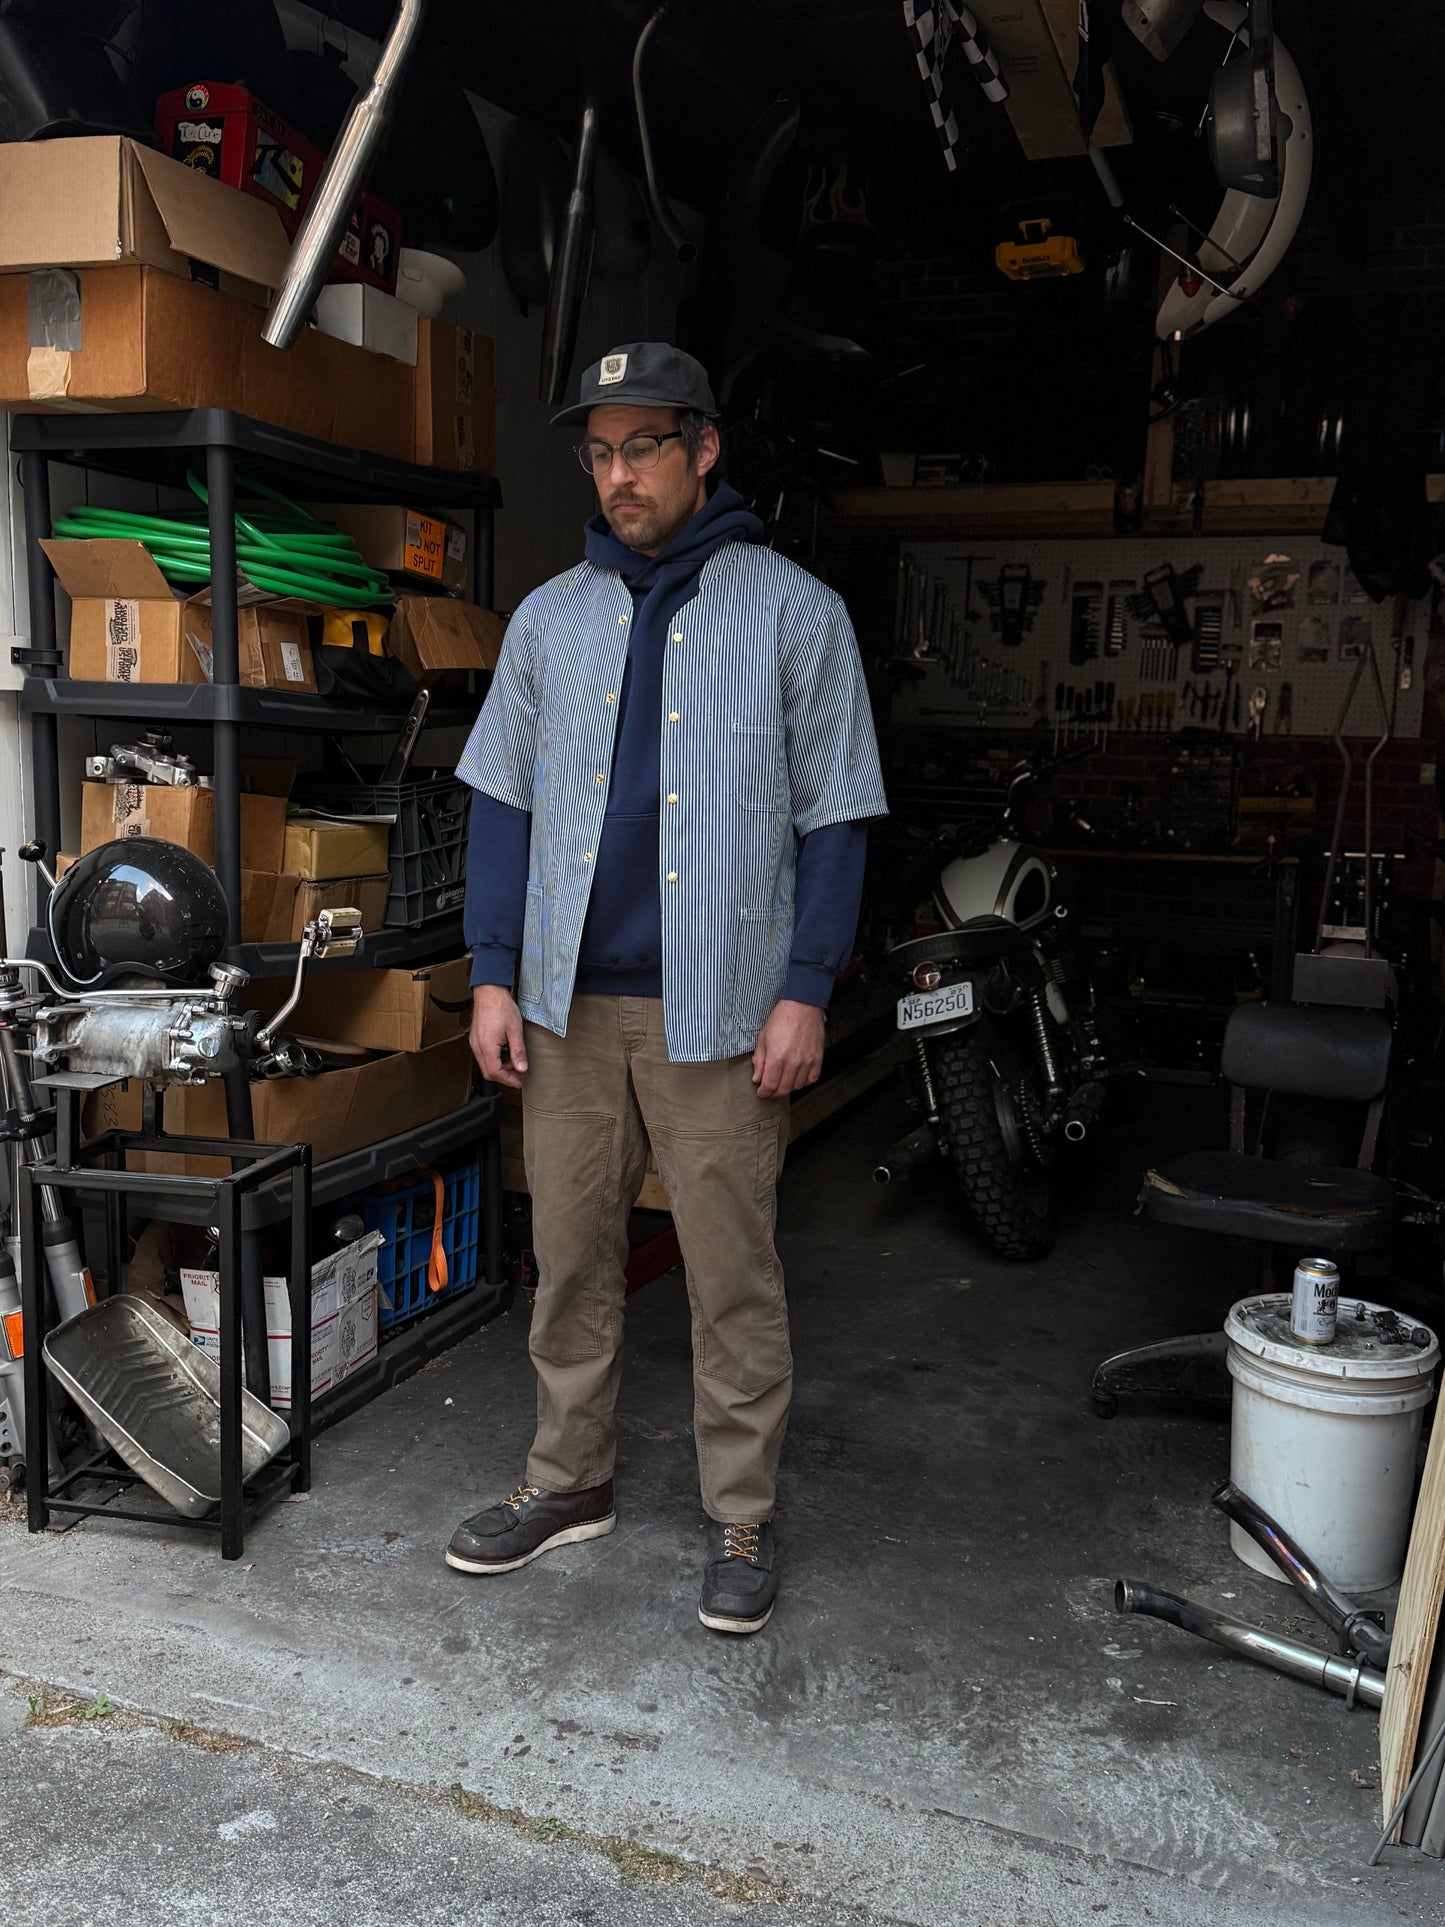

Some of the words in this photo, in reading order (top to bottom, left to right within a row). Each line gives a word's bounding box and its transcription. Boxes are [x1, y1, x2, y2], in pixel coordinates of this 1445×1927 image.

[420, 519, 433, 536] KIT
[423, 539, 441, 557] NOT
[413, 553, 436, 573] SPLIT
[903, 993, 966, 1022] N56250
[908, 997, 921, 1006] SEP
[183, 1273, 210, 1281] PRIORIT
[191, 1279, 208, 1287] MAIL
